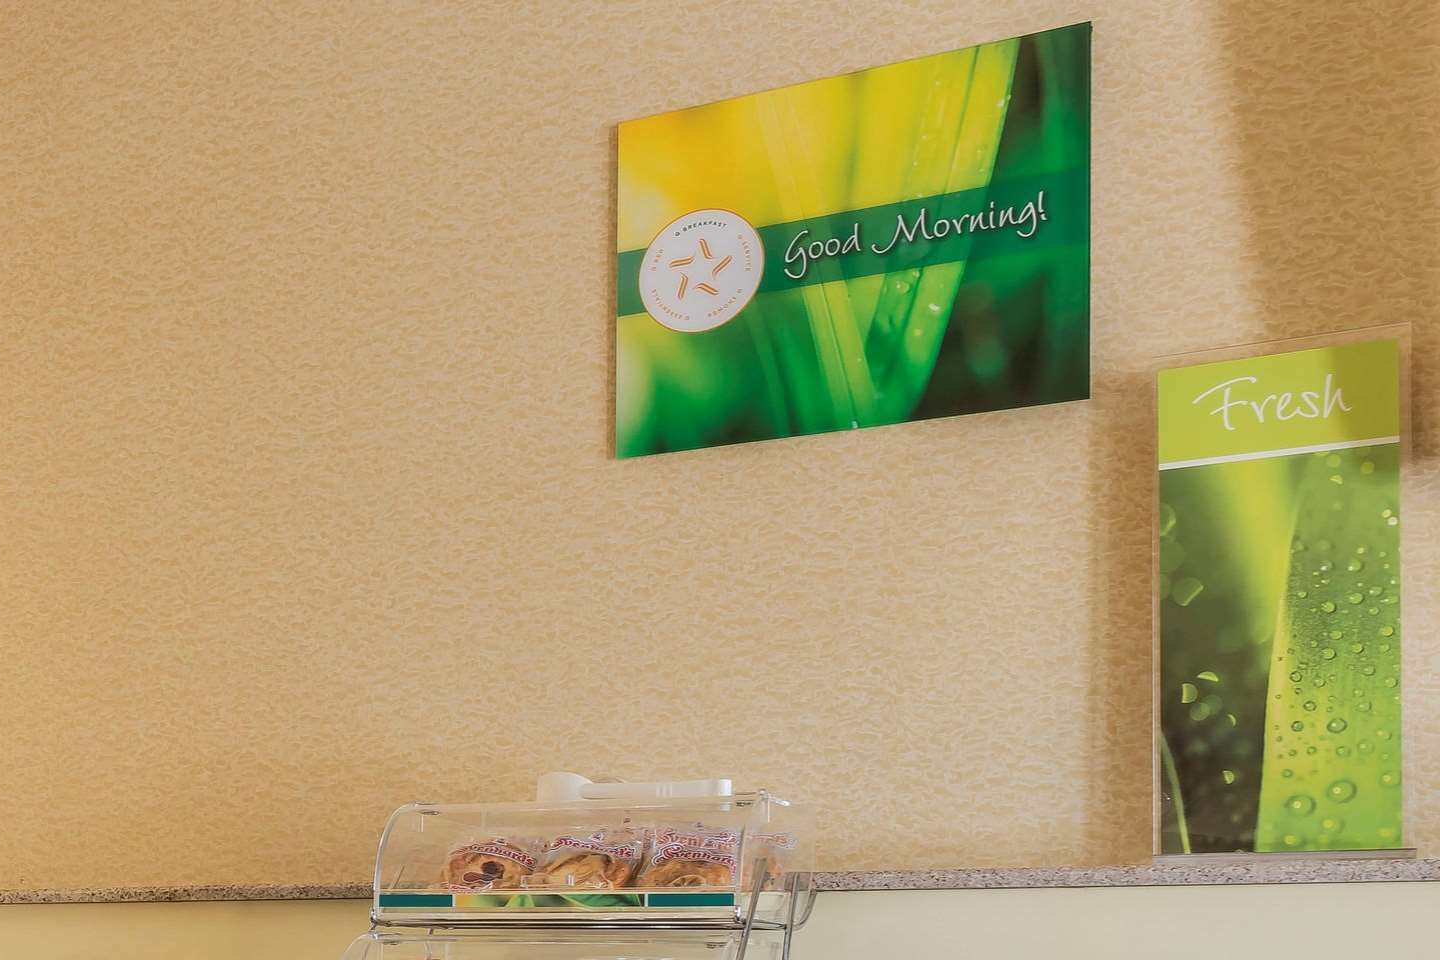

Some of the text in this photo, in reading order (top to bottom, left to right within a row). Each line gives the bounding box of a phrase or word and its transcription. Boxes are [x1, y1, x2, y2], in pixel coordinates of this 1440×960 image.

[783, 190, 1048, 279] Good Morning!
[1192, 373, 1353, 431] Fresh
